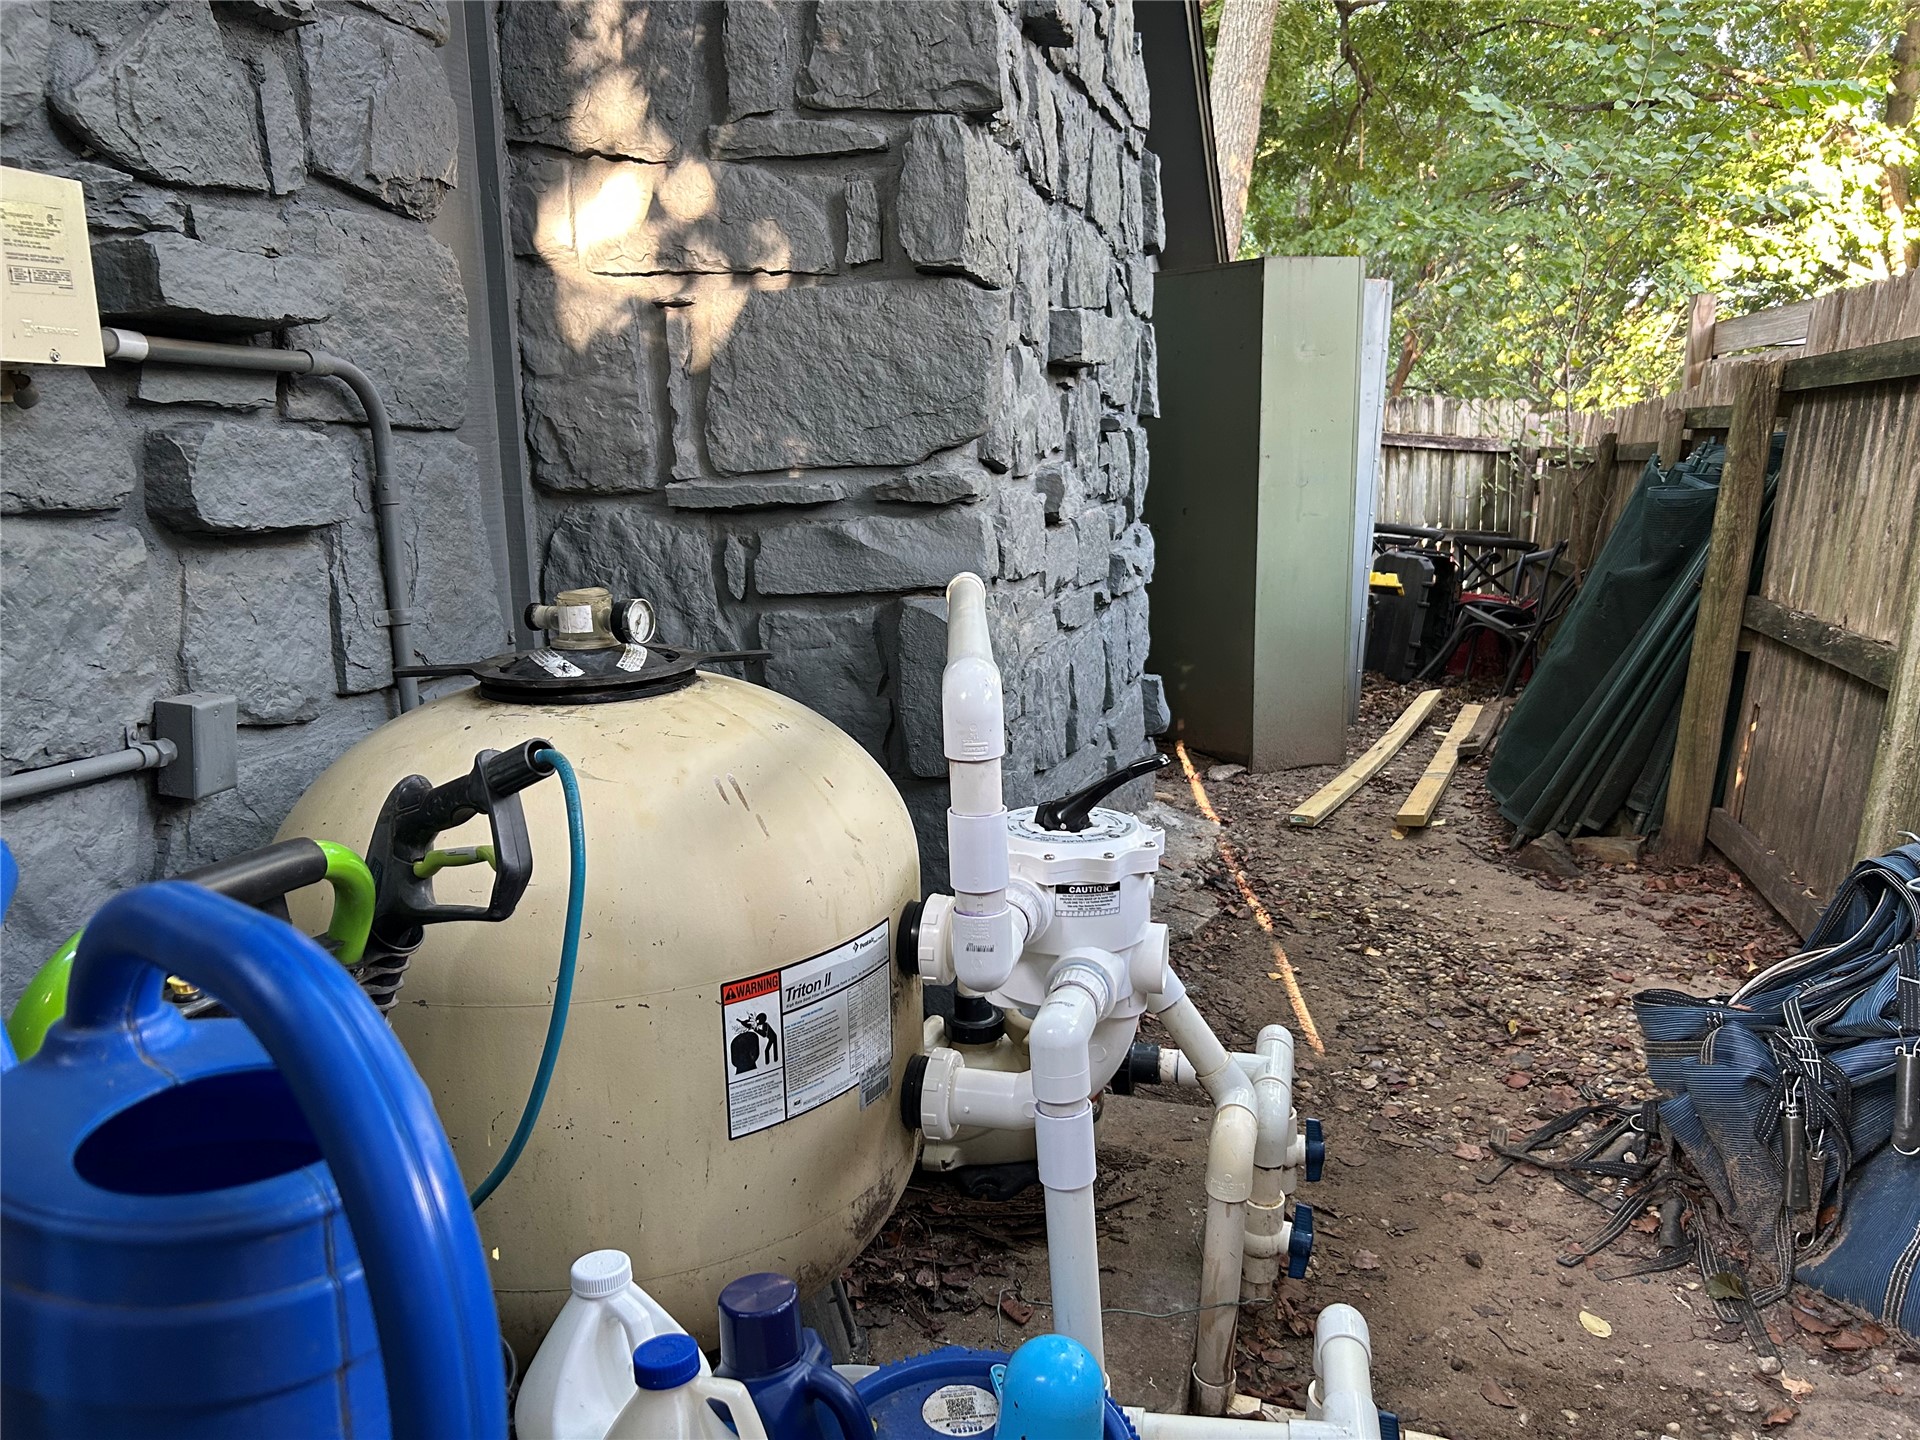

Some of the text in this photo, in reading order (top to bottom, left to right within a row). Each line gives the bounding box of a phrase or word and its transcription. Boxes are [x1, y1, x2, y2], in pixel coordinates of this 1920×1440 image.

[1068, 885, 1109, 894] CAUTION
[735, 975, 779, 998] WARNING
[785, 971, 832, 1003] Triton II
